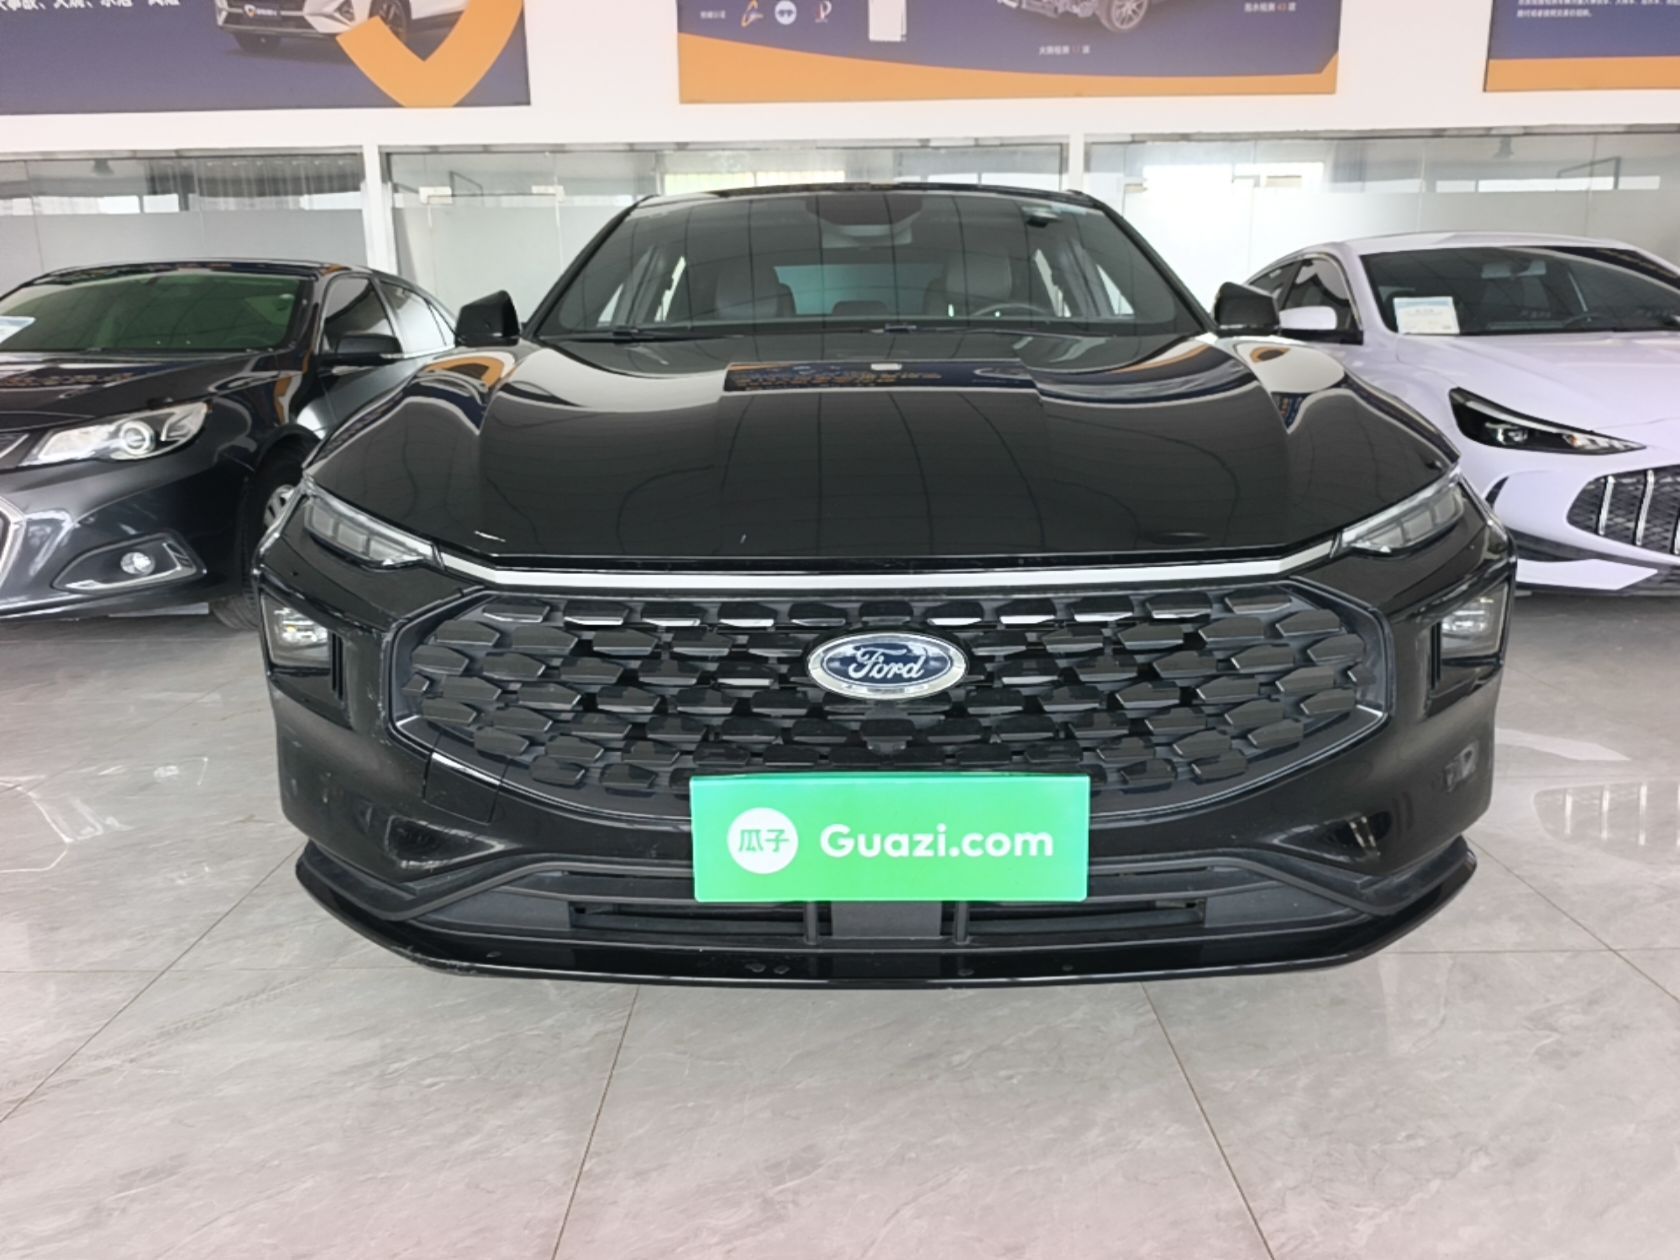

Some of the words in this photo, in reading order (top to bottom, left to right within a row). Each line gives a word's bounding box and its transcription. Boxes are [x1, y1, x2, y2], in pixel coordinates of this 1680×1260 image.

[848, 646, 927, 679] Ford
[738, 828, 789, 853] 瓜子
[820, 823, 1054, 859] Guazi.com
